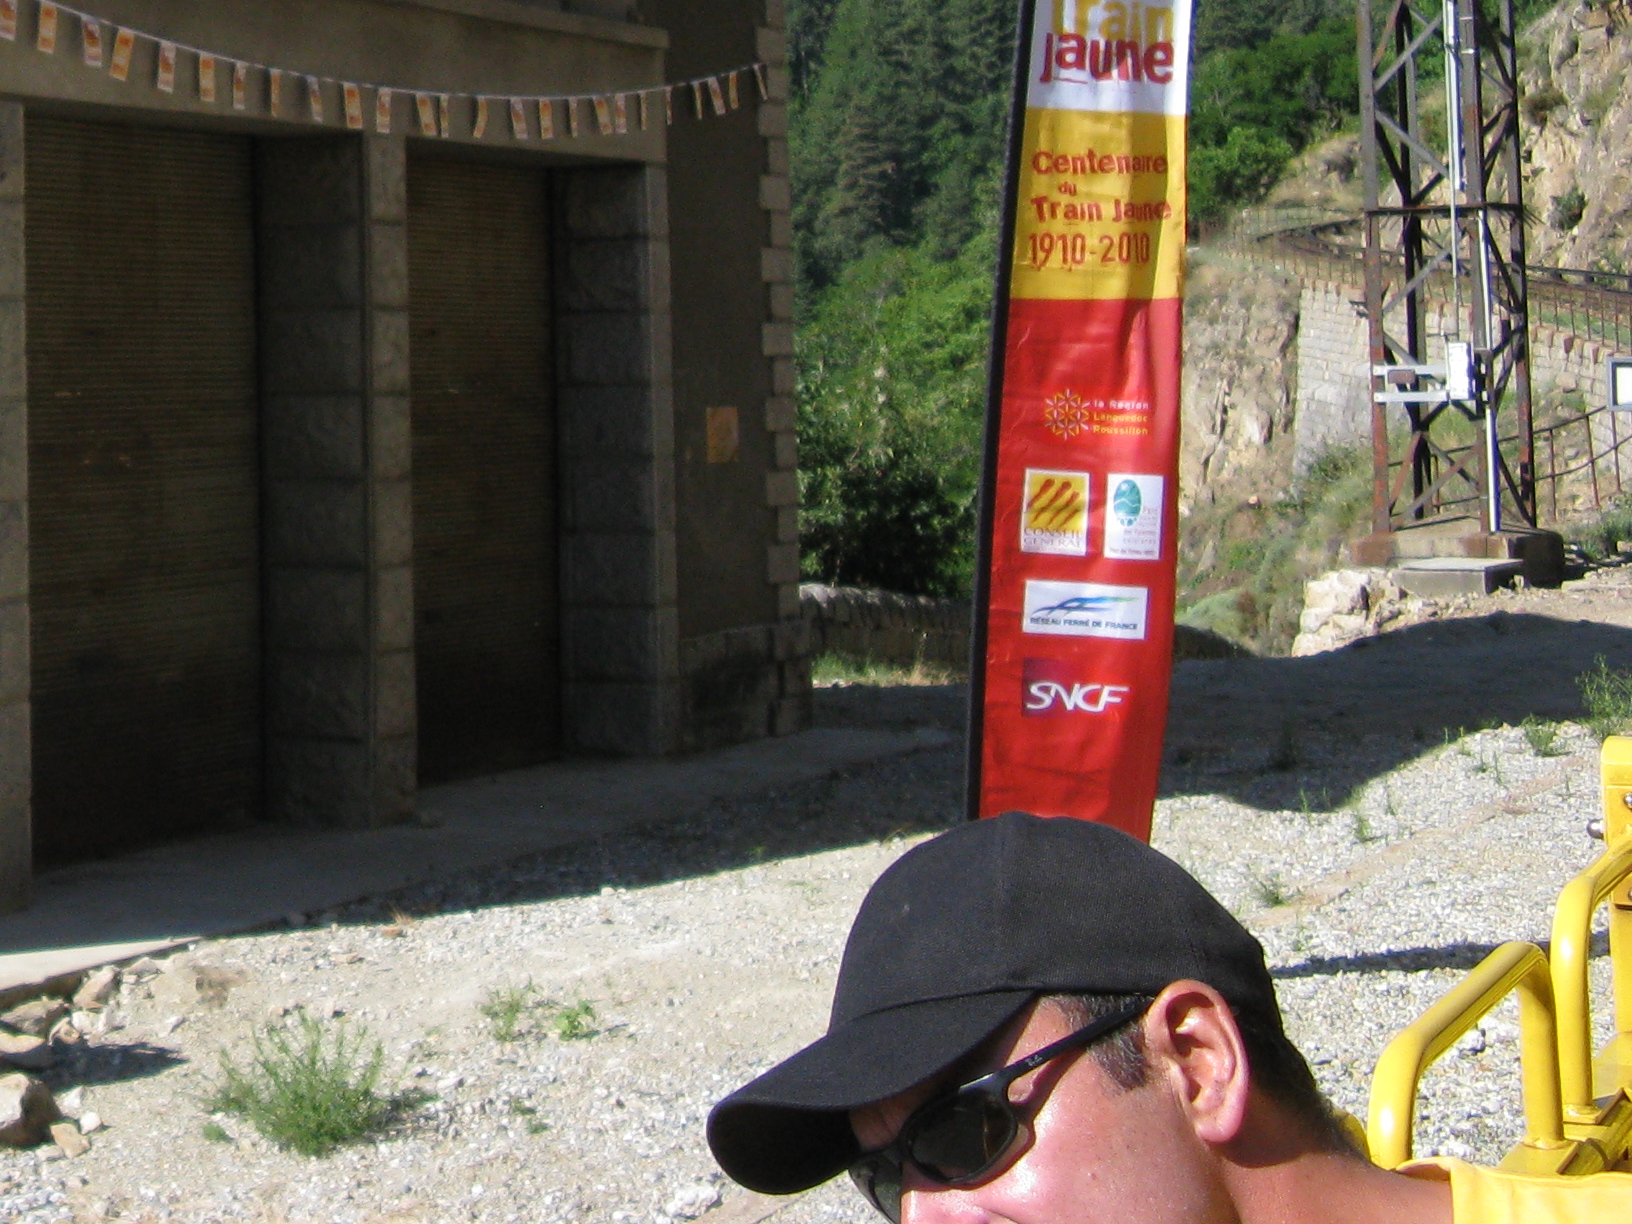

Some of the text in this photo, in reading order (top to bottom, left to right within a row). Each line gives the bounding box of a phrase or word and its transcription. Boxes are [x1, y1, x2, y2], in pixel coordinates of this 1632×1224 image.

[1032, 148, 1168, 174] Centenaire
[1058, 181, 1077, 196] du
[1030, 196, 1103, 222] Train
[1112, 198, 1172, 222] Jaune
[1029, 232, 1150, 267] 1910-2010
[1093, 412, 1148, 423] Languedoc
[1093, 425, 1148, 435] Roussillon
[1105, 621, 1138, 630] FRANCE
[1026, 681, 1132, 713] SNCF
